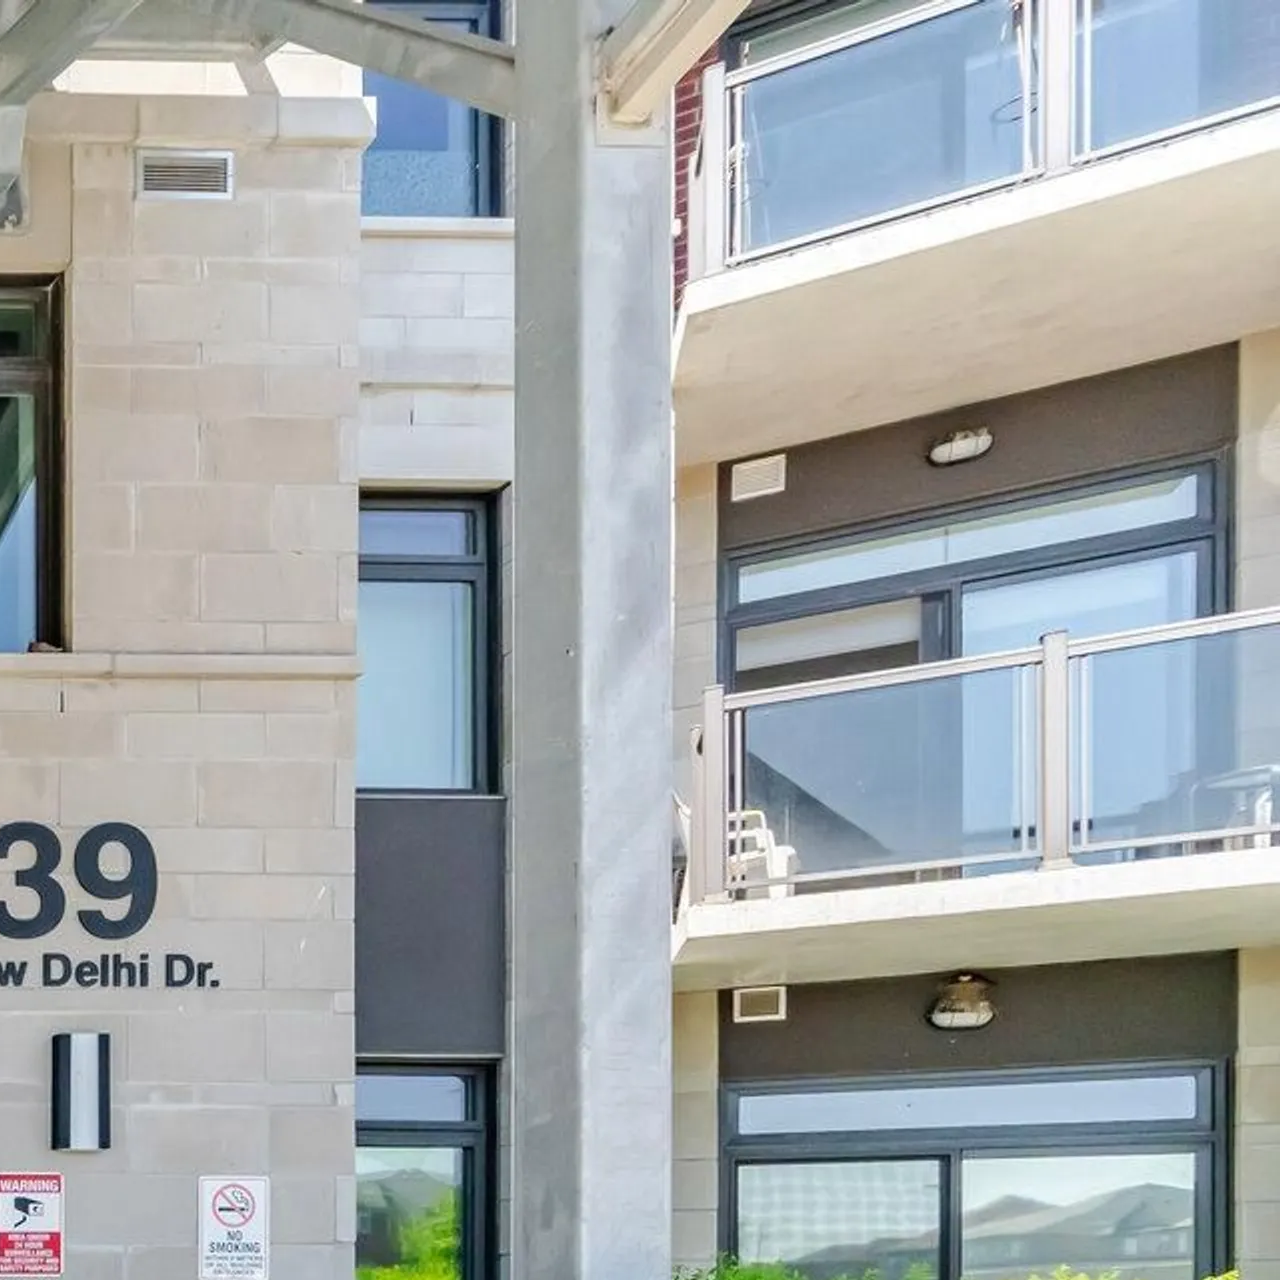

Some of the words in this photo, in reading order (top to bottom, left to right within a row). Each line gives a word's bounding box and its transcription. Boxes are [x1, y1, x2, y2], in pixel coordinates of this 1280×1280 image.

[42, 952, 149, 988] Delhi
[164, 952, 220, 988] Dr.
[0, 1179, 59, 1192] WARNING
[226, 1230, 243, 1241] NO
[208, 1242, 261, 1253] SMOKING
